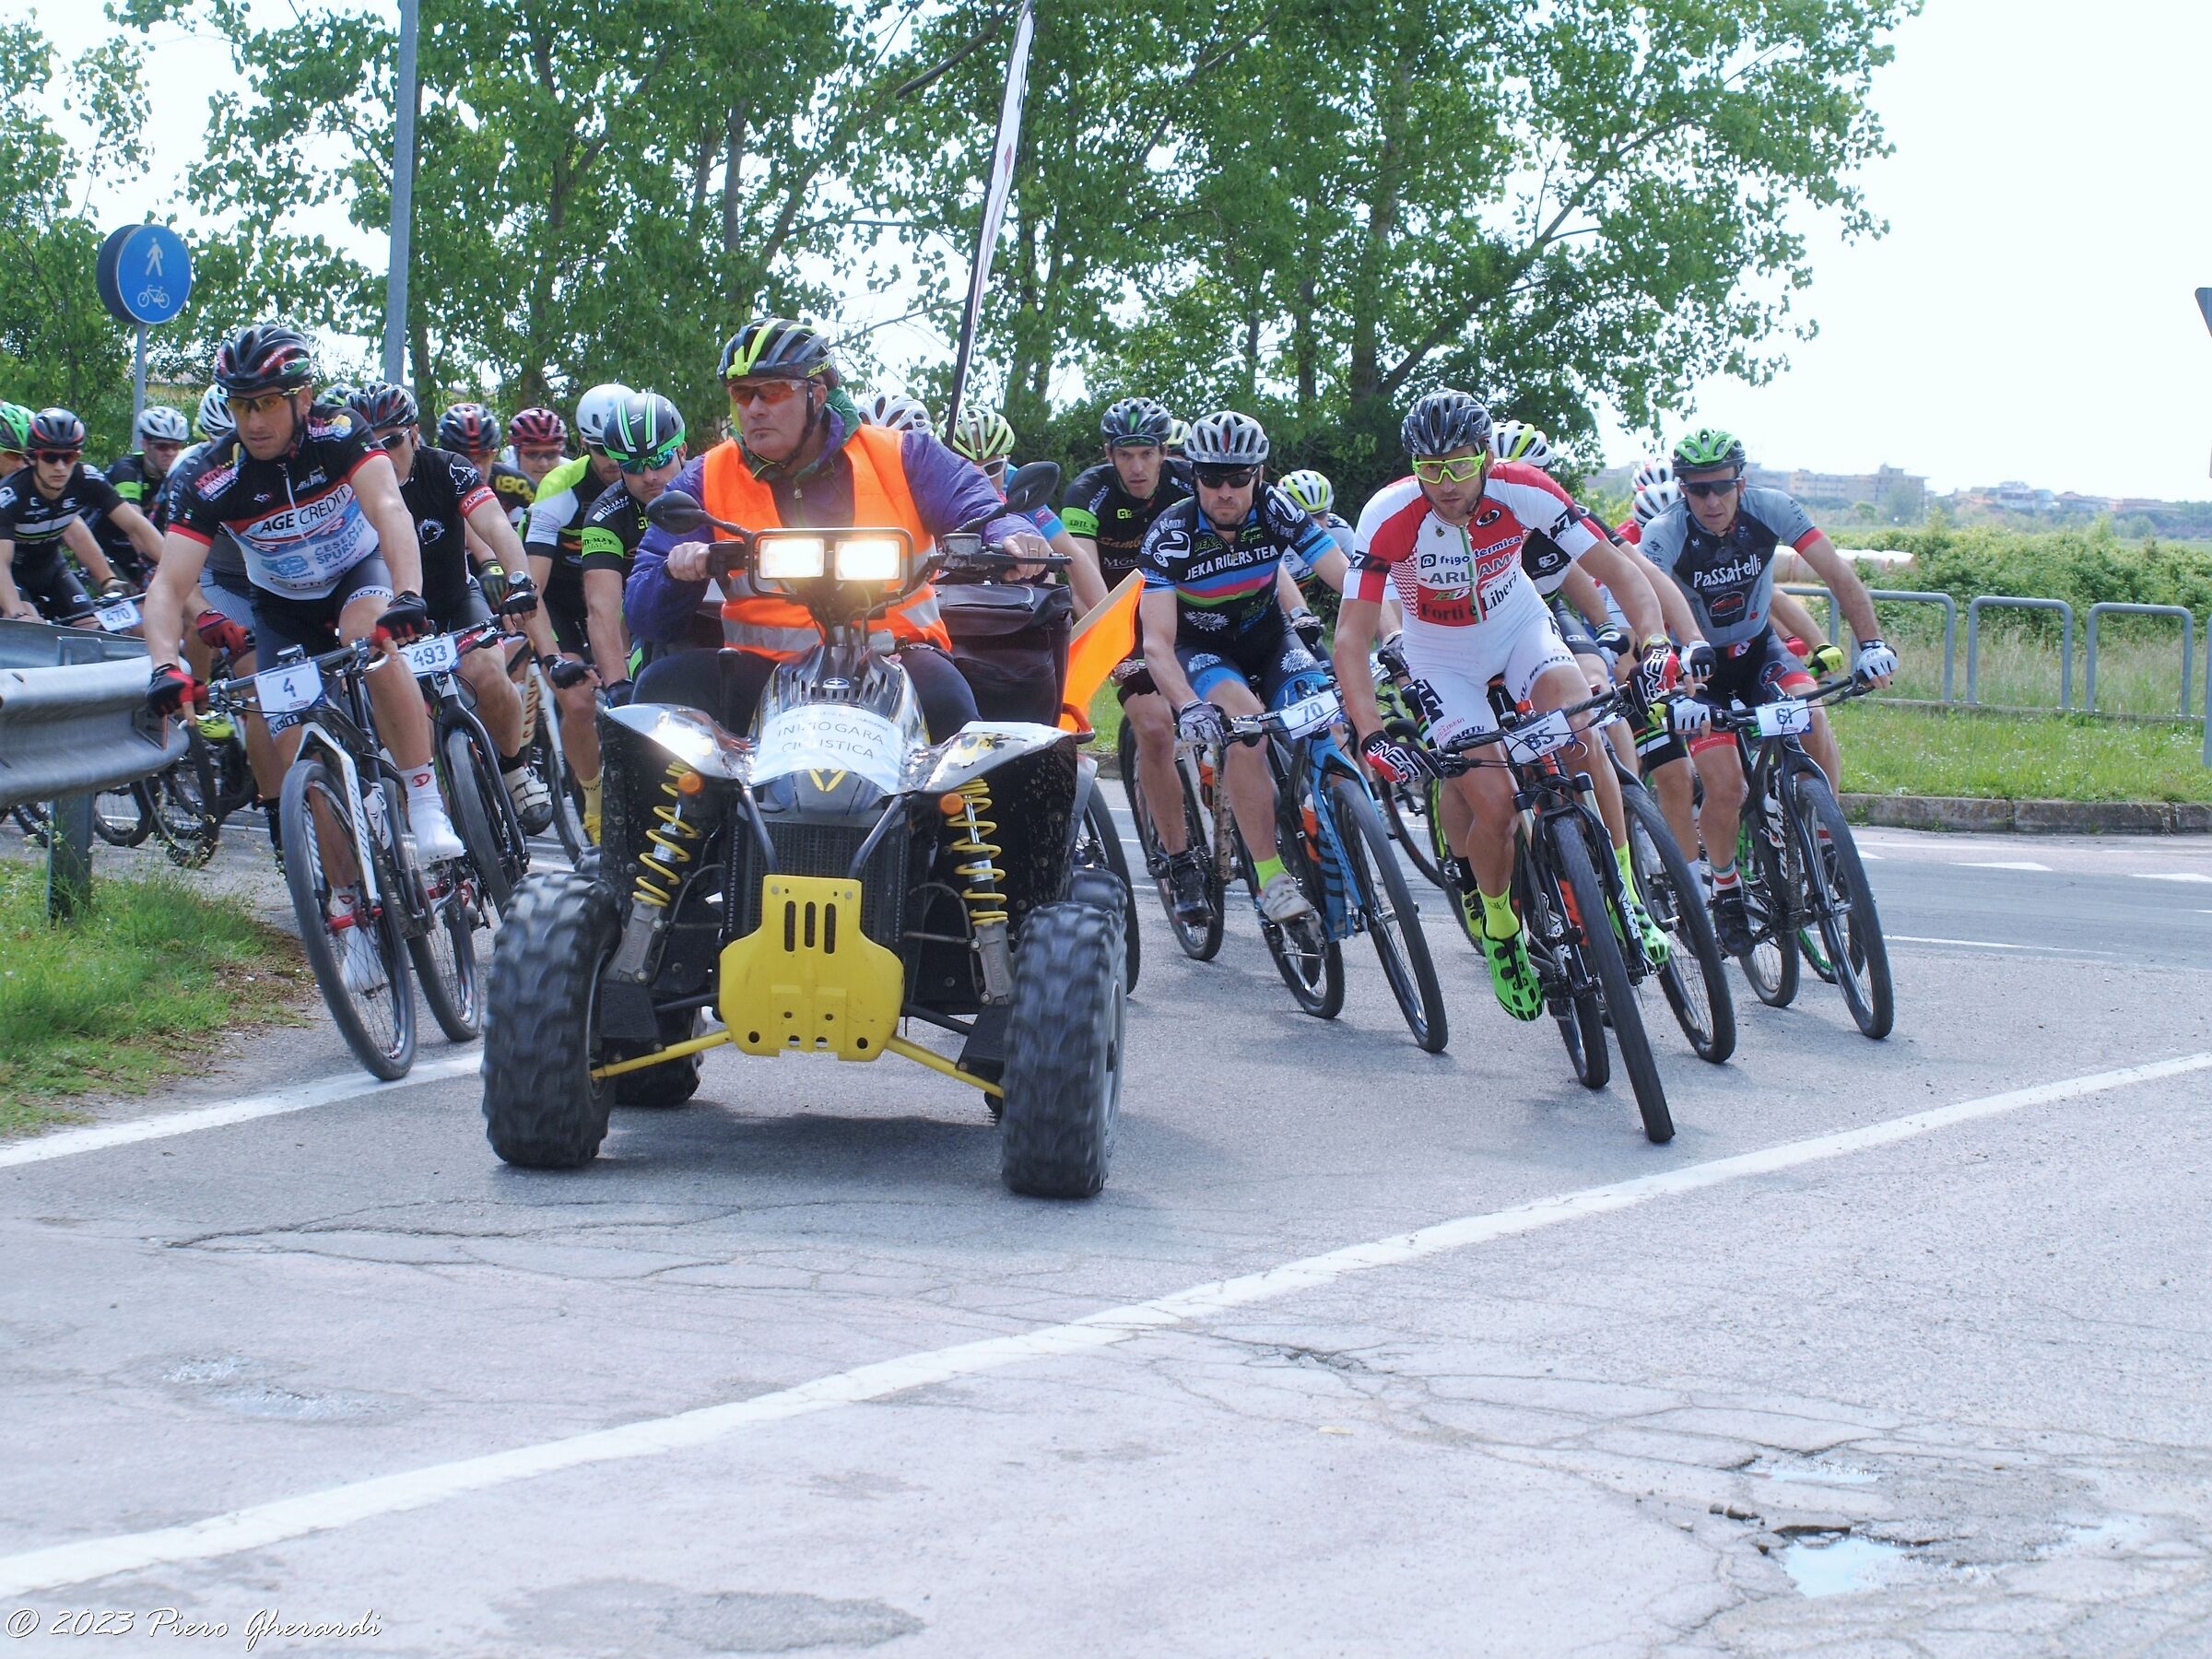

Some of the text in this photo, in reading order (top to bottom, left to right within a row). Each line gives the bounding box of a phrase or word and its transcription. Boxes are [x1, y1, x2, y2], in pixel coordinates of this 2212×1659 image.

[806, 361, 830, 378] SCO
[260, 512, 295, 534] AGE
[1475, 535, 1522, 559] termica
[1215, 550, 1253, 571] RIDERS
[1693, 553, 1761, 589] Passatelli
[1482, 571, 1517, 611] Liberi
[105, 607, 132, 624] 470
[413, 643, 448, 666] 493
[283, 677, 297, 698] 4
[1298, 701, 1324, 723] 70
[1775, 707, 1793, 724] 61
[834, 723, 885, 745] GARA
[1524, 726, 1555, 749] 85
[782, 738, 875, 759] CIISTICA
